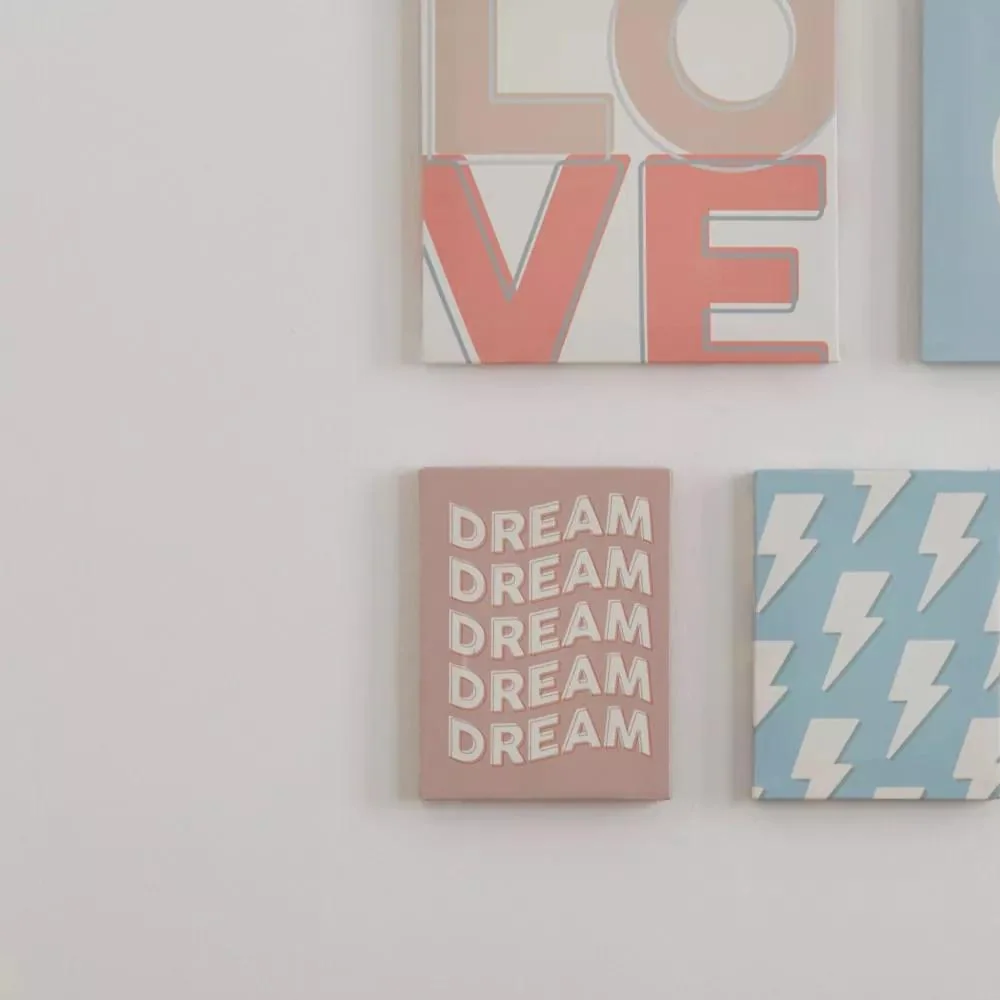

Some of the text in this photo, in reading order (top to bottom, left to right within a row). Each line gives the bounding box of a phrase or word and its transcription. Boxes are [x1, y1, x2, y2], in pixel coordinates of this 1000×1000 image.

[422, 154, 829, 364] VE
[449, 492, 653, 553] DREAM
[449, 546, 652, 606] DREAM
[448, 599, 652, 660] DREAM
[448, 652, 652, 712] DREAM
[448, 705, 651, 766] DREAM
